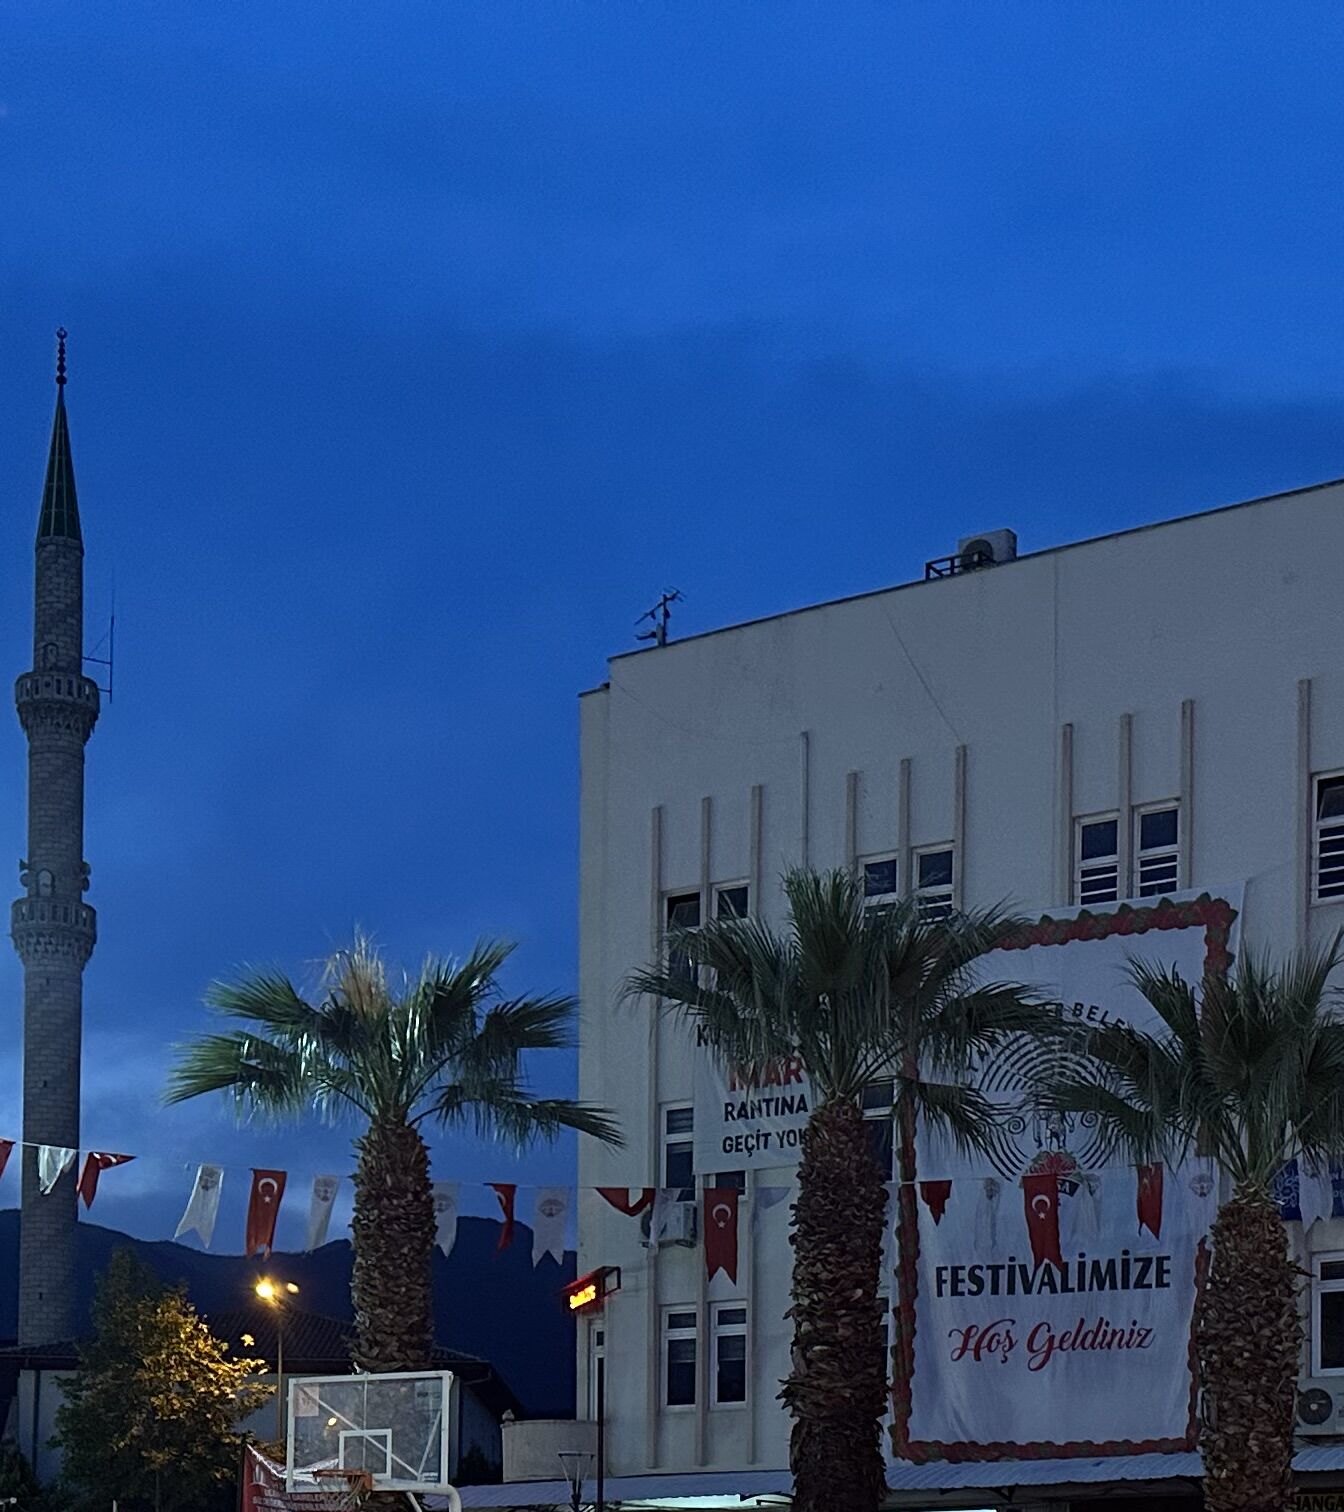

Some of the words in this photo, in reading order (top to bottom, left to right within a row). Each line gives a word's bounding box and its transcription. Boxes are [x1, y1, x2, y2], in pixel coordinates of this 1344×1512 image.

[724, 1094, 809, 1122] RANTINA
[722, 1129, 772, 1157] GEÇİT
[935, 1249, 1171, 1298] FESTİVALİMİZE
[948, 1318, 1018, 1364] Hoş
[1027, 1316, 1155, 1372] Geldiniz
